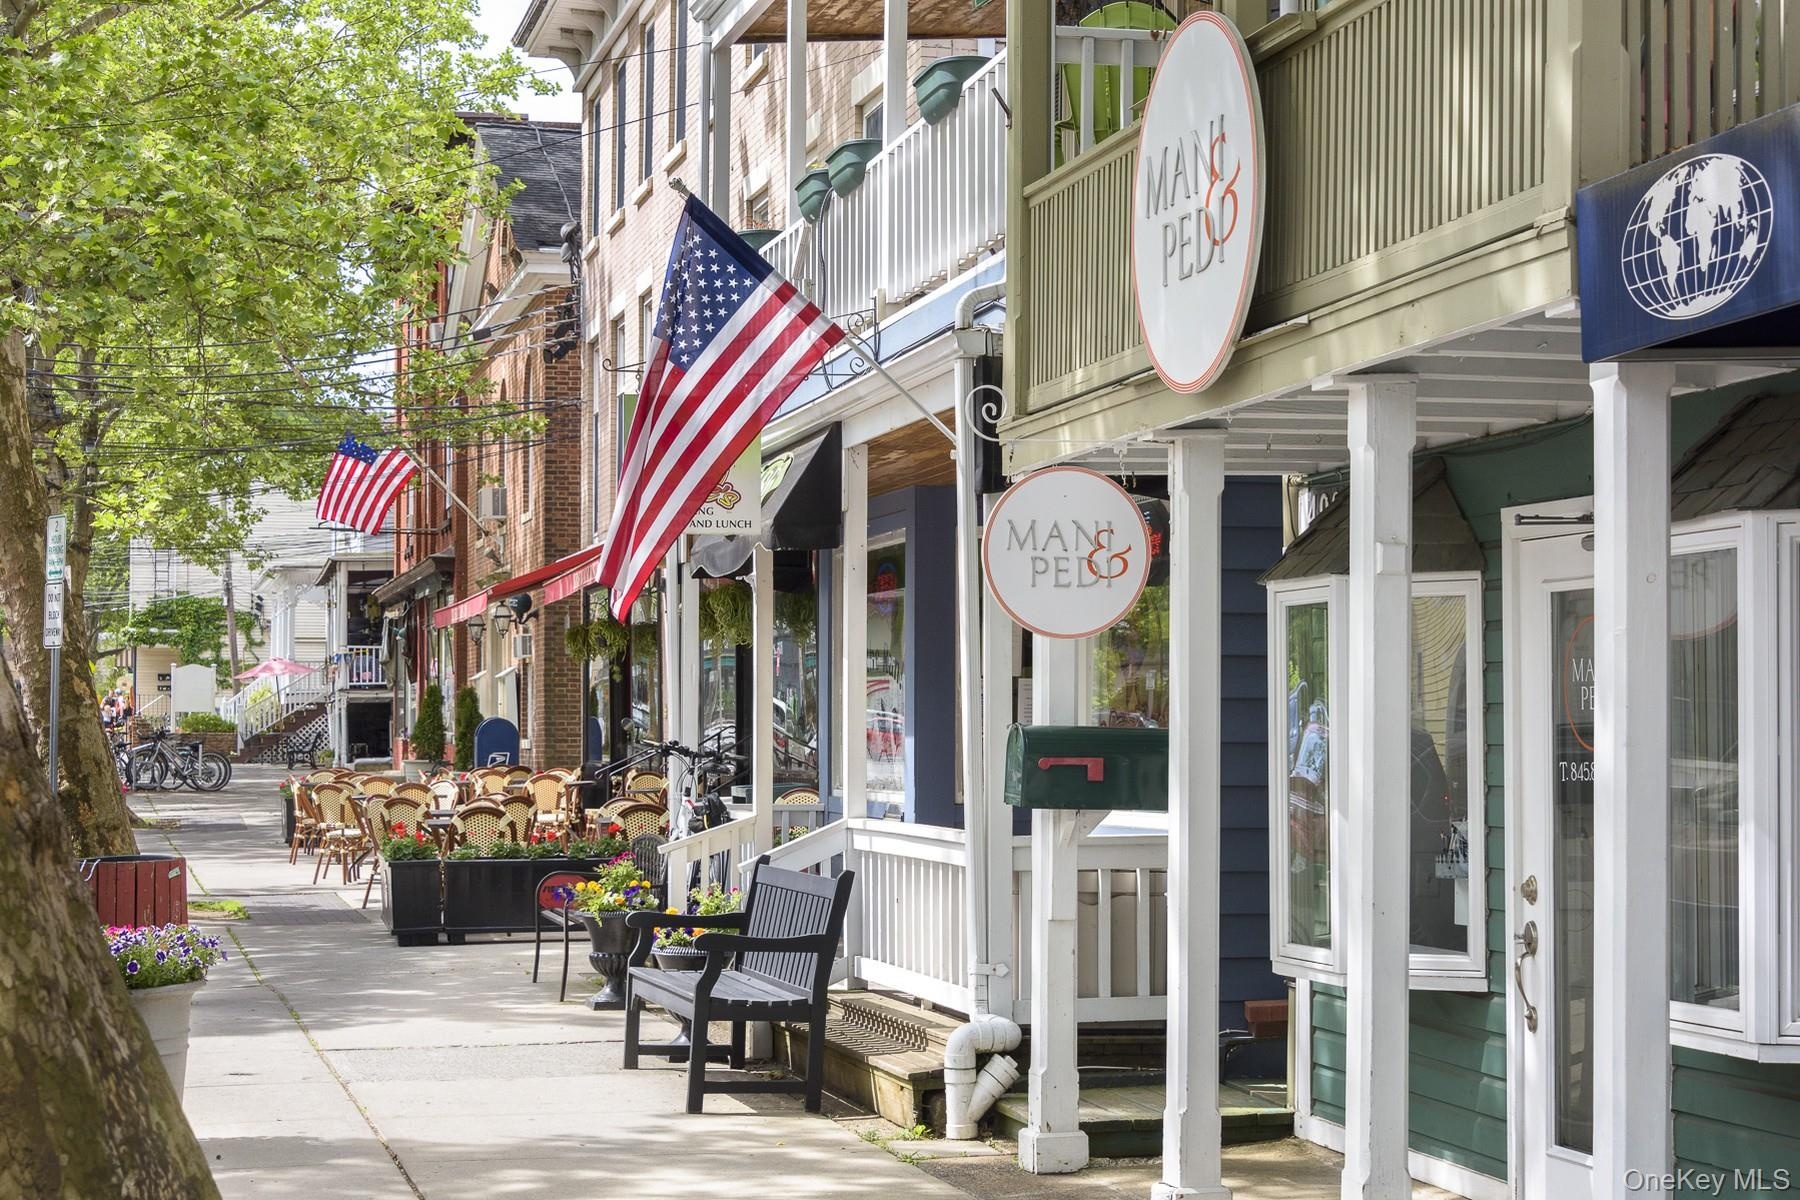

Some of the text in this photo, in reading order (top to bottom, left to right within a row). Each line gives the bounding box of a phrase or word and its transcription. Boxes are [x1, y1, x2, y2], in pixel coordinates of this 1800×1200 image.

[1146, 114, 1241, 247] MANI &
[1162, 195, 1225, 288] PEDI
[54, 521, 59, 532] 2
[689, 520, 752, 528] AND LUNCH
[1006, 519, 1113, 551] MANI
[1086, 528, 1132, 580] &
[1030, 556, 1113, 588] PEDI
[1559, 762, 1569, 782] T.
